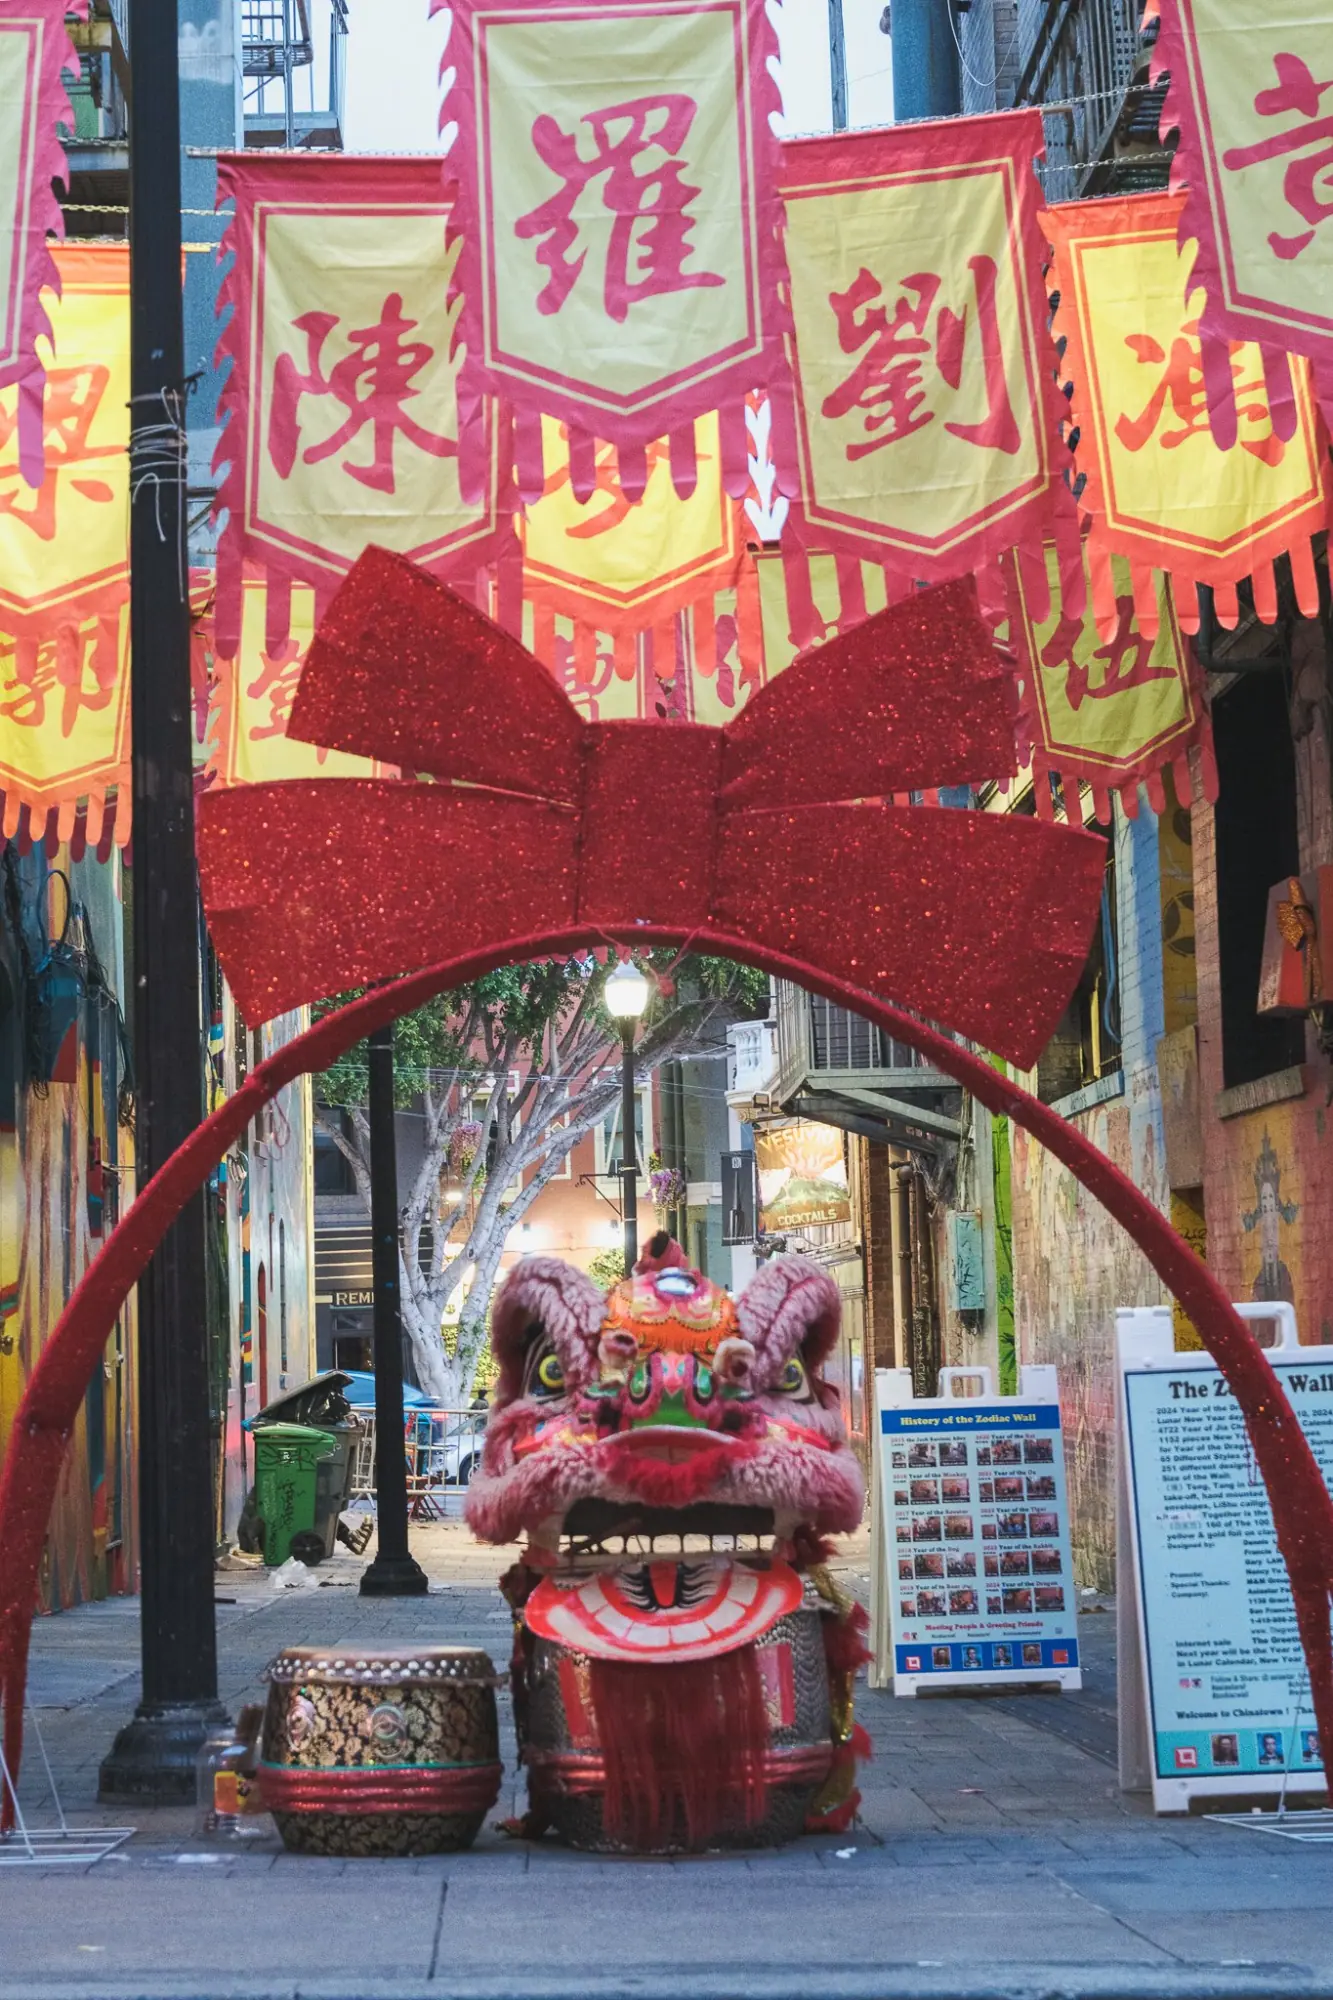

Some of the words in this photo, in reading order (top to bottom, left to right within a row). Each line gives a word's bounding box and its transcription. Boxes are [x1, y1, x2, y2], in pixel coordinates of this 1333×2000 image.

[514, 94, 726, 323] 羅
[821, 254, 1021, 461] 劉
[267, 292, 458, 494] 陳
[778, 1209, 836, 1226] COCKTAILS
[1169, 1381, 1208, 1399] The
[1287, 1374, 1333, 1393] Wall
[901, 1417, 940, 1426] History
[975, 1414, 1010, 1423] Zodiac
[1207, 1530, 1226, 1539] gold
[1200, 1650, 1218, 1658] year
[1176, 1711, 1218, 1719] Welcome
[1233, 1708, 1284, 1717] Chinatown
